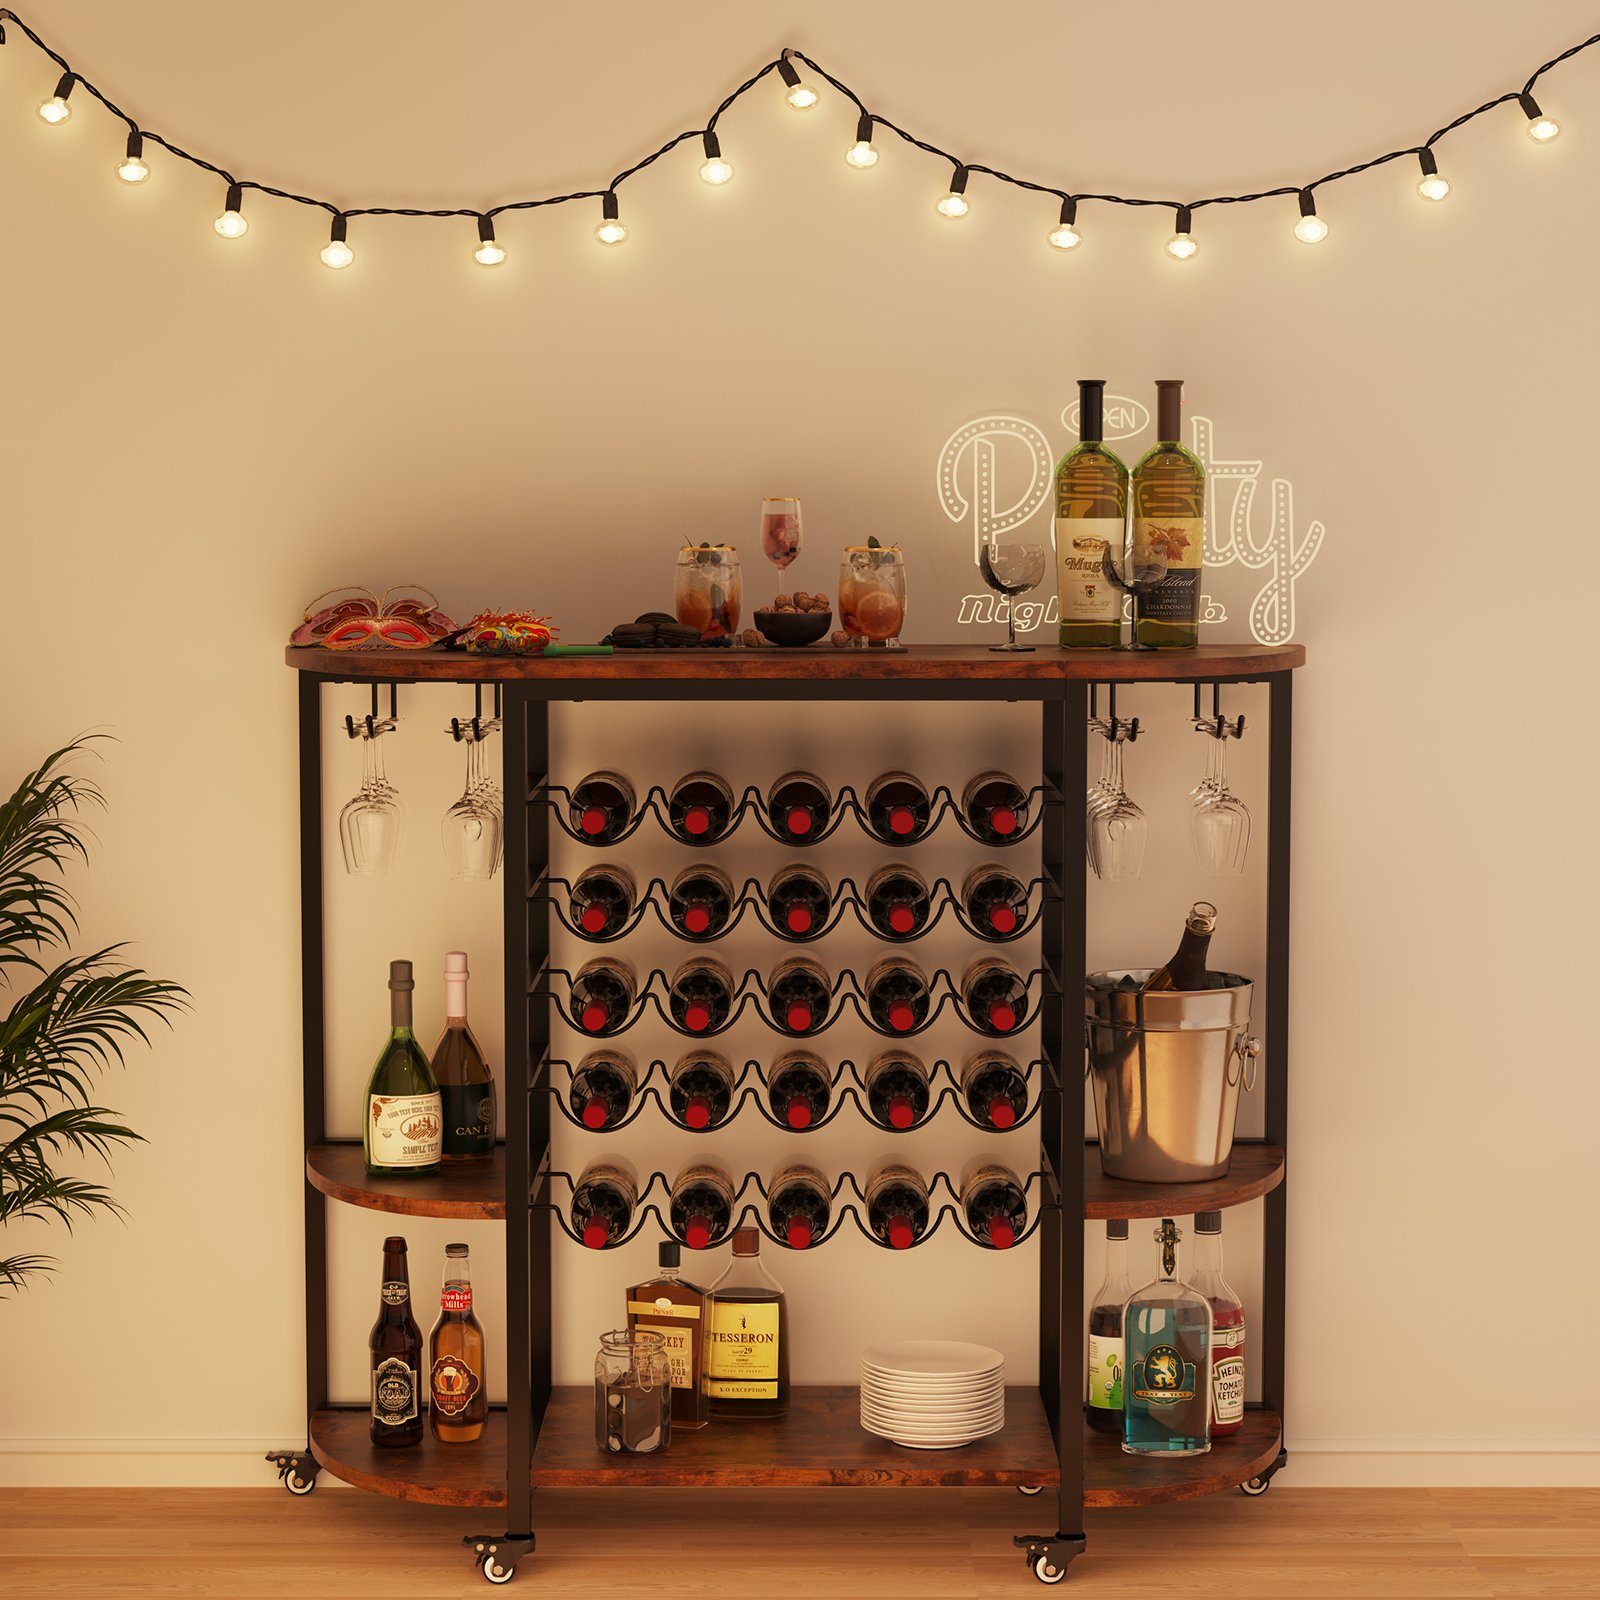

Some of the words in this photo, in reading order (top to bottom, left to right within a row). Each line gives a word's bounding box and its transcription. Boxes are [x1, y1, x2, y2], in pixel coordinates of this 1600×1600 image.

[937, 416, 1326, 647] Pty
[402, 1145, 426, 1155] SAMPLE
[712, 1332, 774, 1343] TESSERON
